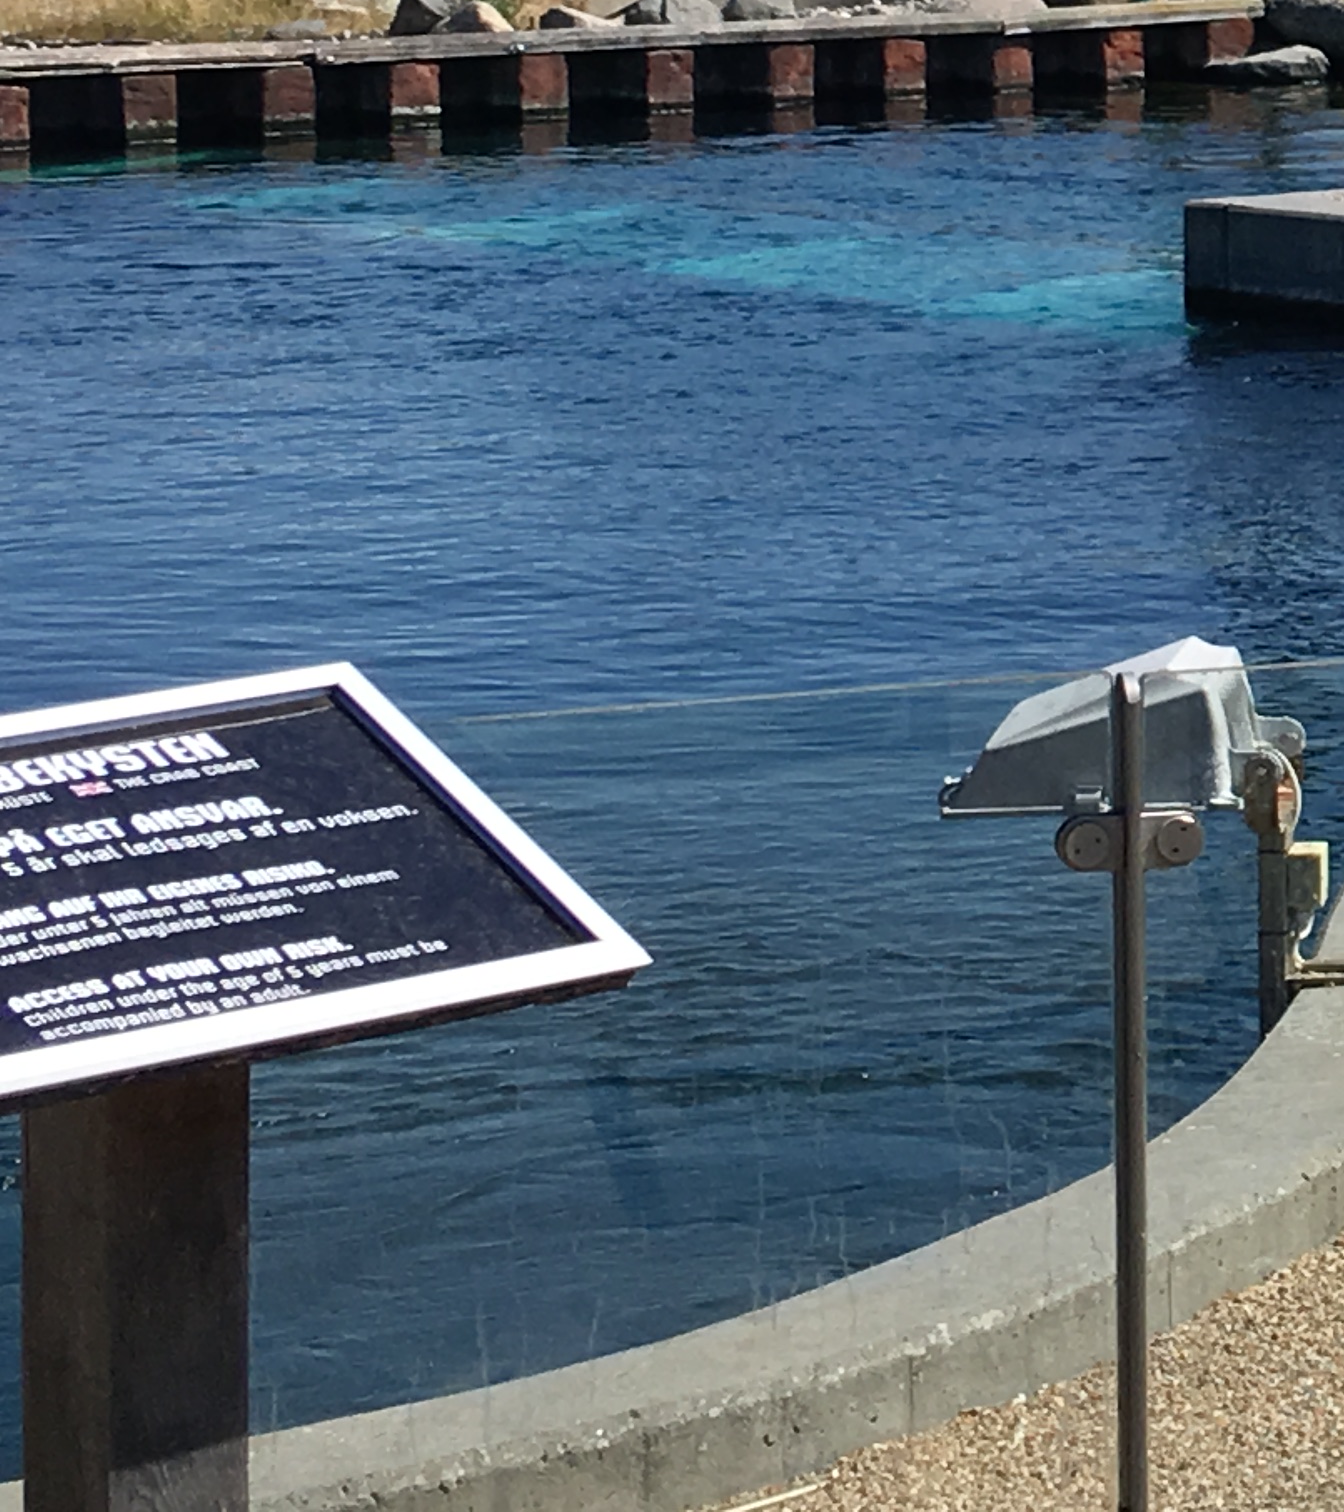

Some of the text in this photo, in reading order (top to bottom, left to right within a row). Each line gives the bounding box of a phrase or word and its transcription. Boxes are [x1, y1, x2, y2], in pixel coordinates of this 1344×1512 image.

[112, 775, 151, 790] THE
[201, 757, 261, 777] COAST
[26, 855, 58, 874] år
[61, 843, 124, 868] skal
[121, 828, 248, 858] ledsages
[249, 819, 278, 839] af
[280, 816, 317, 834] en
[317, 803, 420, 829] voksen.
[45, 817, 127, 848] EGET
[130, 796, 284, 835] ANSVAR.
[31, 918, 90, 941] unter
[89, 914, 110, 928] 5
[179, 898, 211, 914] alt
[211, 886, 295, 909] müssen
[294, 879, 336, 896] von
[335, 869, 401, 889] einem
[121, 915, 220, 941] begleitet
[7, 935, 355, 1014] ACCESS AT YOUR OWN RISK.
[115, 986, 178, 1008] under
[177, 980, 218, 997] the
[218, 974, 261, 992] age
[261, 966, 285, 984] of
[303, 953, 366, 979] years
[38, 1002, 187, 1041] accompanied
[184, 997, 220, 1016] by
[218, 993, 248, 1010] an
